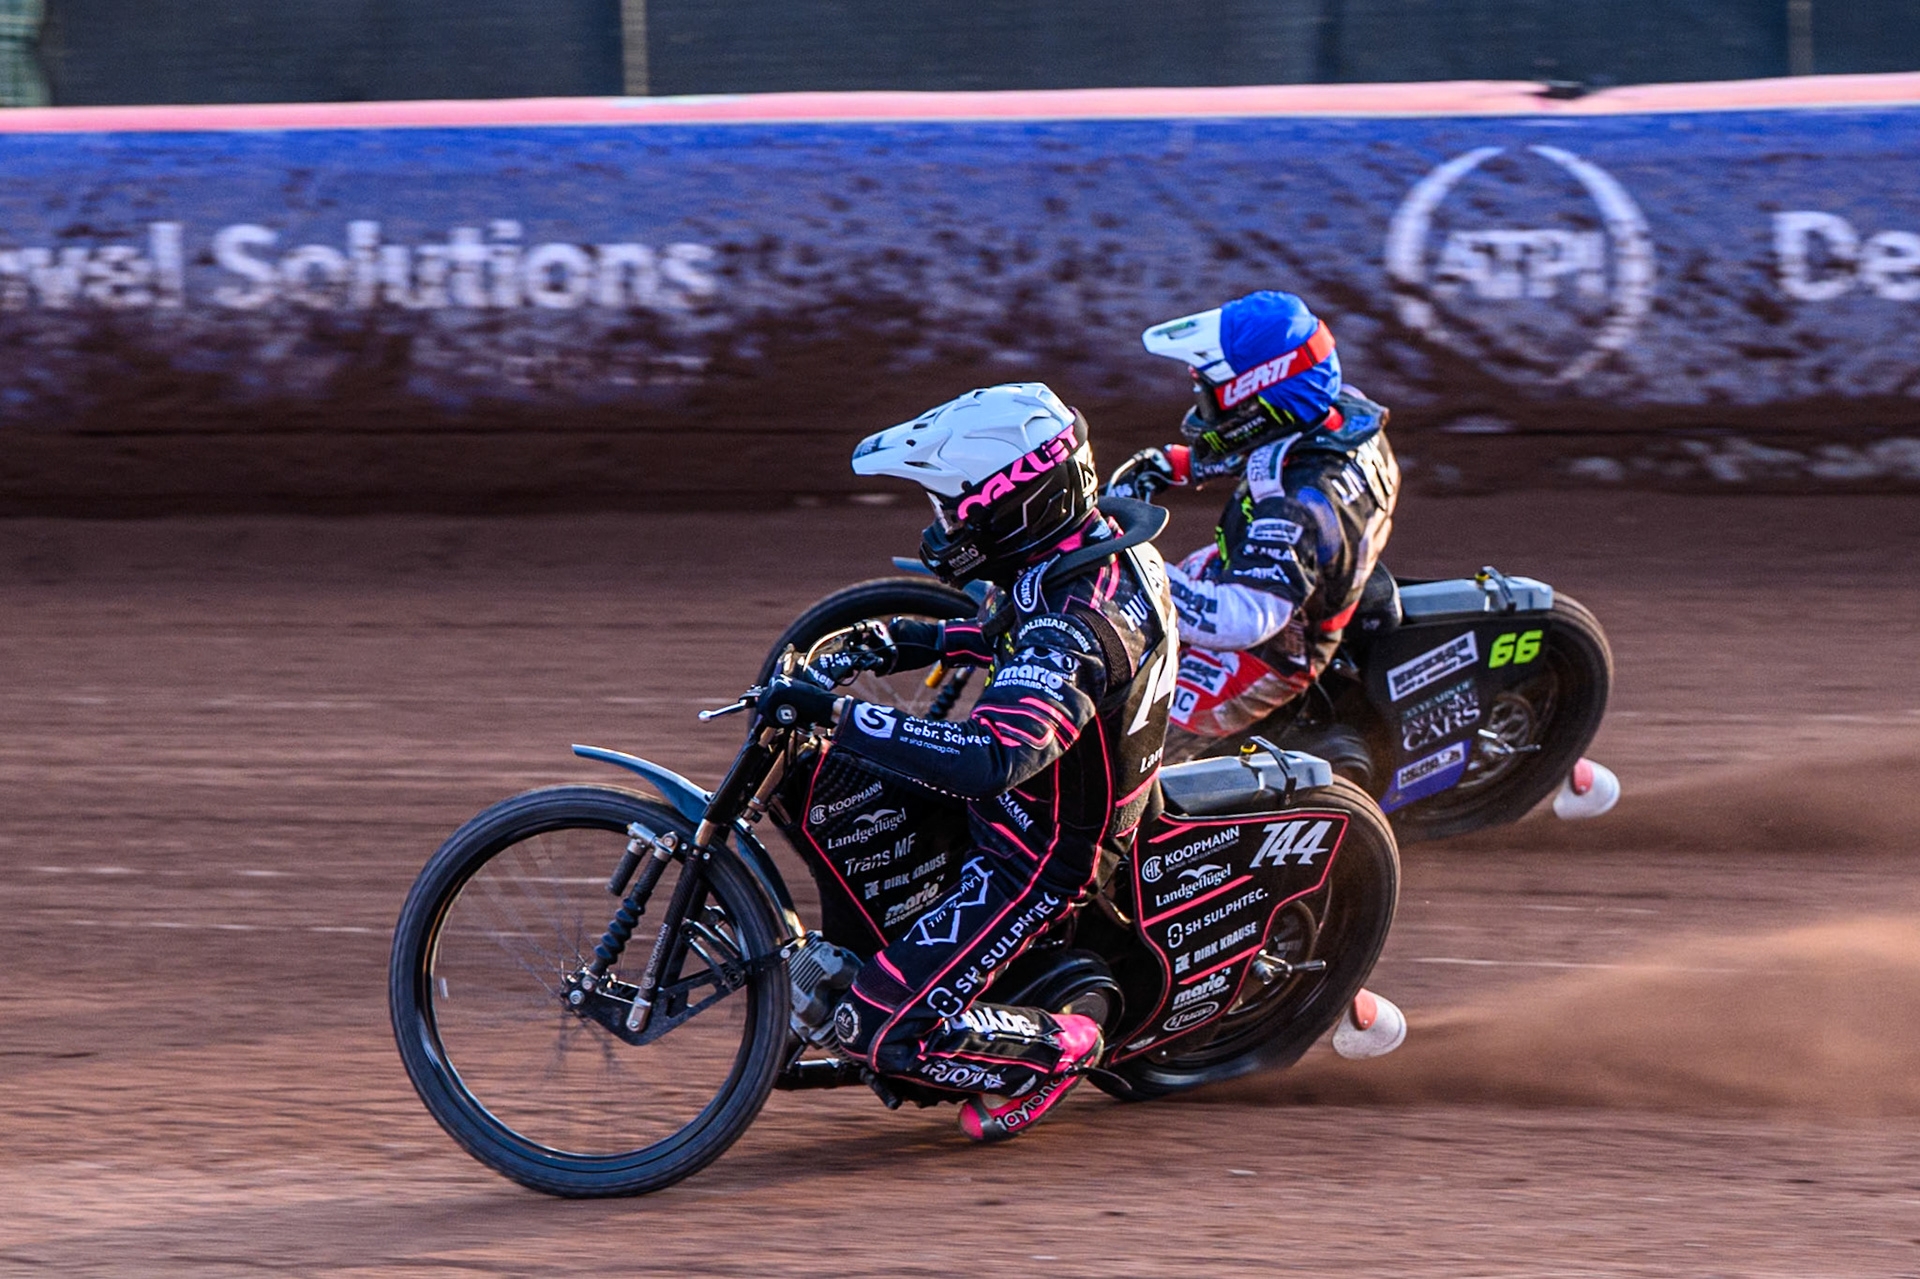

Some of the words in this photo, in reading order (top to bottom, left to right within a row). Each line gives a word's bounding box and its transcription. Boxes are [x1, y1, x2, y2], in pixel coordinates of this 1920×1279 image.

[212, 220, 716, 309] Solutions
[1223, 350, 1298, 407] LEATT
[957, 424, 1079, 520] OAKLEY
[1488, 629, 1543, 669] 66
[902, 721, 940, 740] Gebr.
[1403, 707, 1481, 751] CARS
[828, 781, 883, 813] KOOPMANN
[828, 807, 907, 850] Landgeflügel
[1164, 825, 1240, 866] KOOPMANN
[1249, 820, 1333, 868] 744
[845, 850, 890, 877] Trans
[894, 832, 916, 859] MF
[884, 873, 909, 890] DIRK
[912, 853, 948, 880] KRAUSE
[1155, 863, 1232, 908] Landgeflügel
[1185, 919, 1202, 936] SH
[1204, 888, 1269, 927] SULPHTEC.
[1193, 941, 1218, 963] DIRK
[1220, 922, 1257, 950] KRAUSE
[1173, 967, 1231, 1005] mario's
